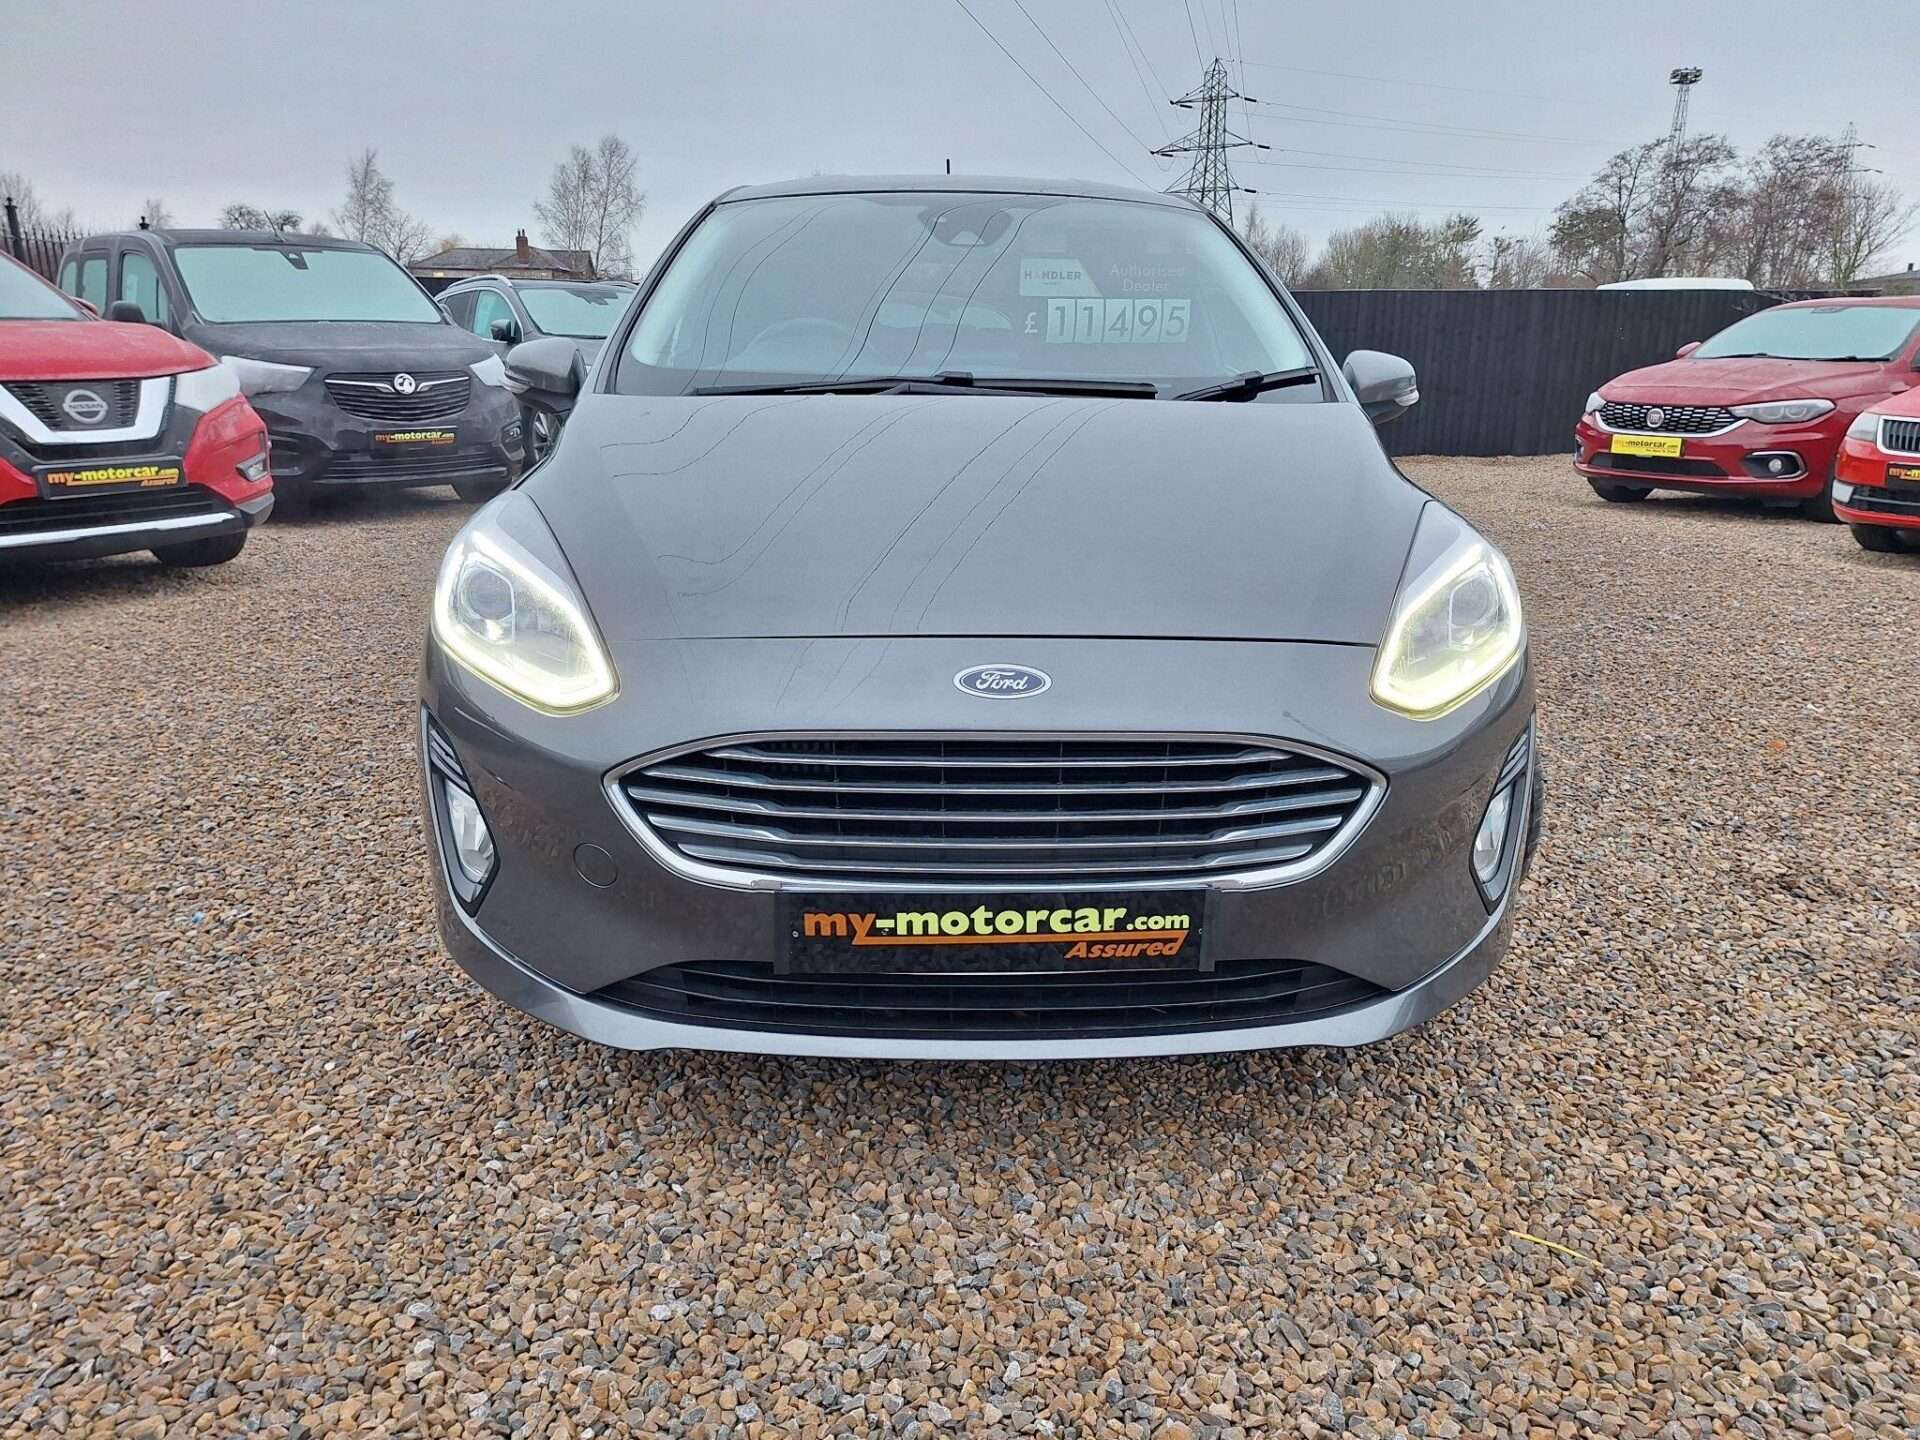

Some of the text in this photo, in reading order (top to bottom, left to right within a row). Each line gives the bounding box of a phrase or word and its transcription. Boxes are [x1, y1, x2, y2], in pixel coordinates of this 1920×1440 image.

[975, 670, 1028, 690] Ford
[803, 904, 1190, 944] my-motorcar.com
[1063, 940, 1187, 960] Assured
